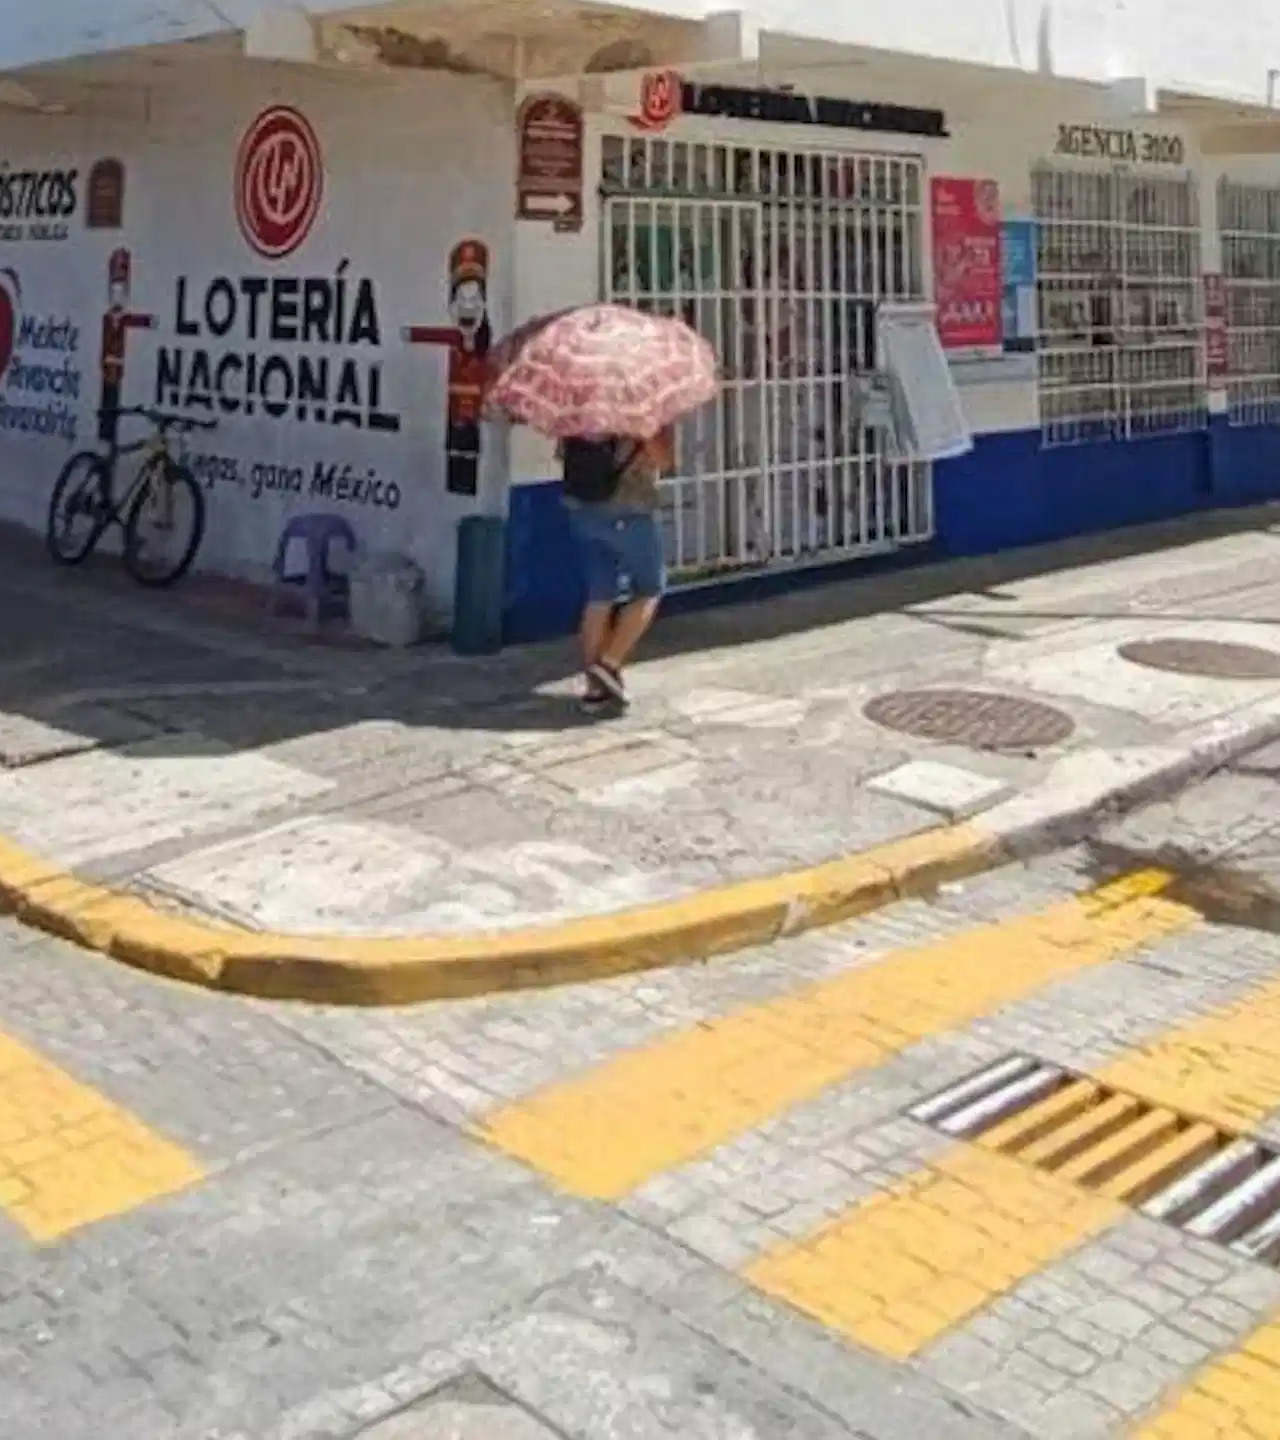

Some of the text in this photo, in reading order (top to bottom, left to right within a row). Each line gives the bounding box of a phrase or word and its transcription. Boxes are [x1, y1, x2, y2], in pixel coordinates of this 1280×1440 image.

[175, 257, 380, 345] LOTERÍA
[156, 346, 400, 432] NACIONAL
[251, 463, 303, 499] gana
[309, 462, 401, 509] México
